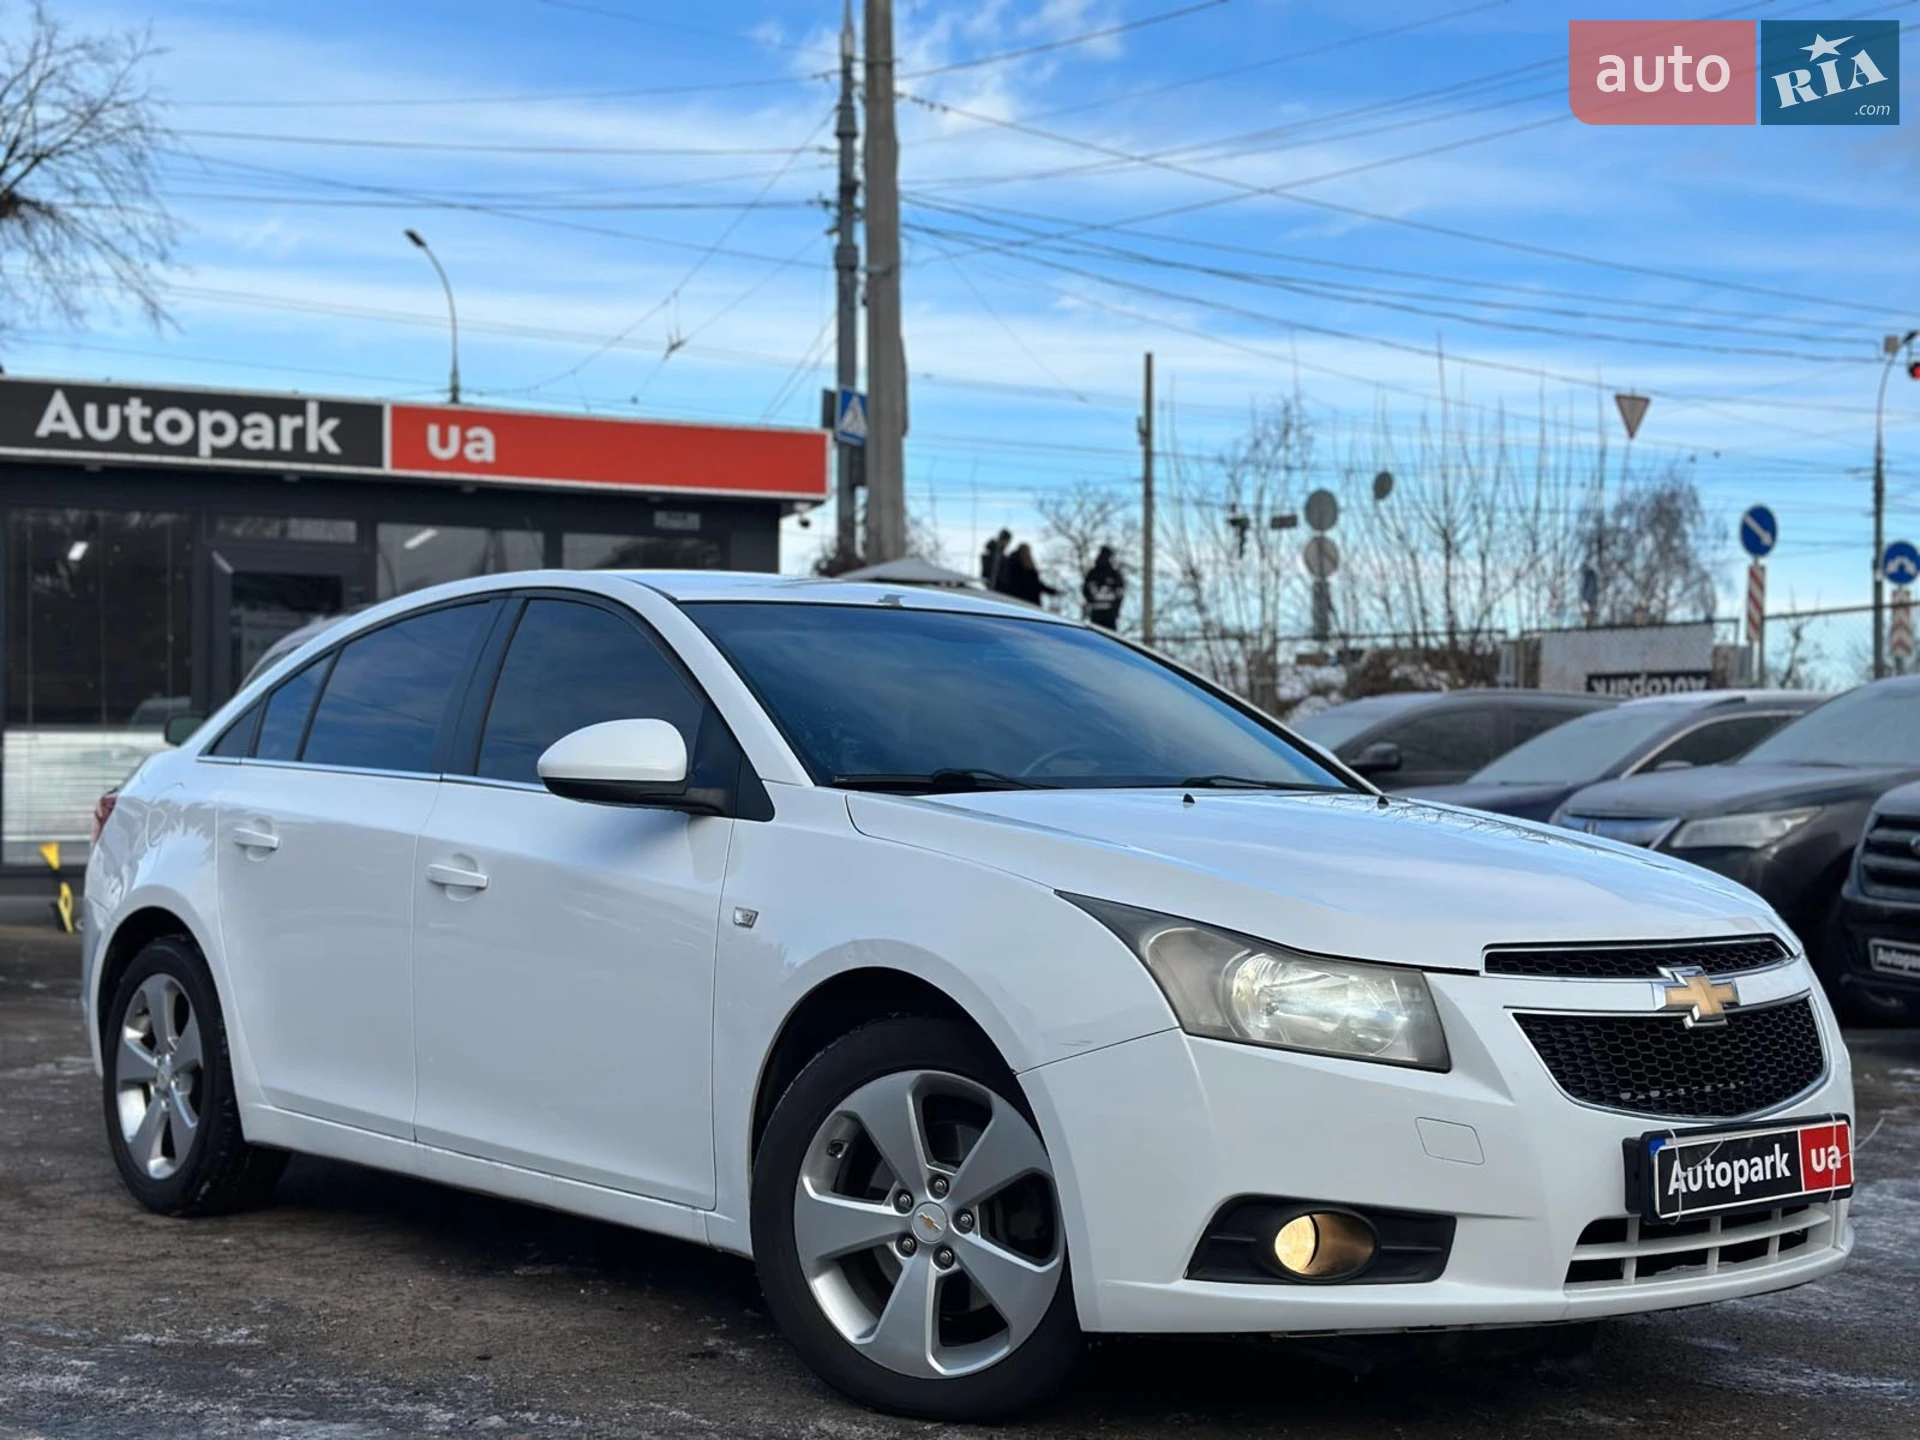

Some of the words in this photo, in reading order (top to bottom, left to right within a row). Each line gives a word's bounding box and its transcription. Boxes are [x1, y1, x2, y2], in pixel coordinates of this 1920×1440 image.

[35, 389, 341, 457] Autopark
[426, 423, 496, 463] ua
[1667, 1143, 1791, 1195] Autopark
[1810, 1145, 1842, 1173] ua
